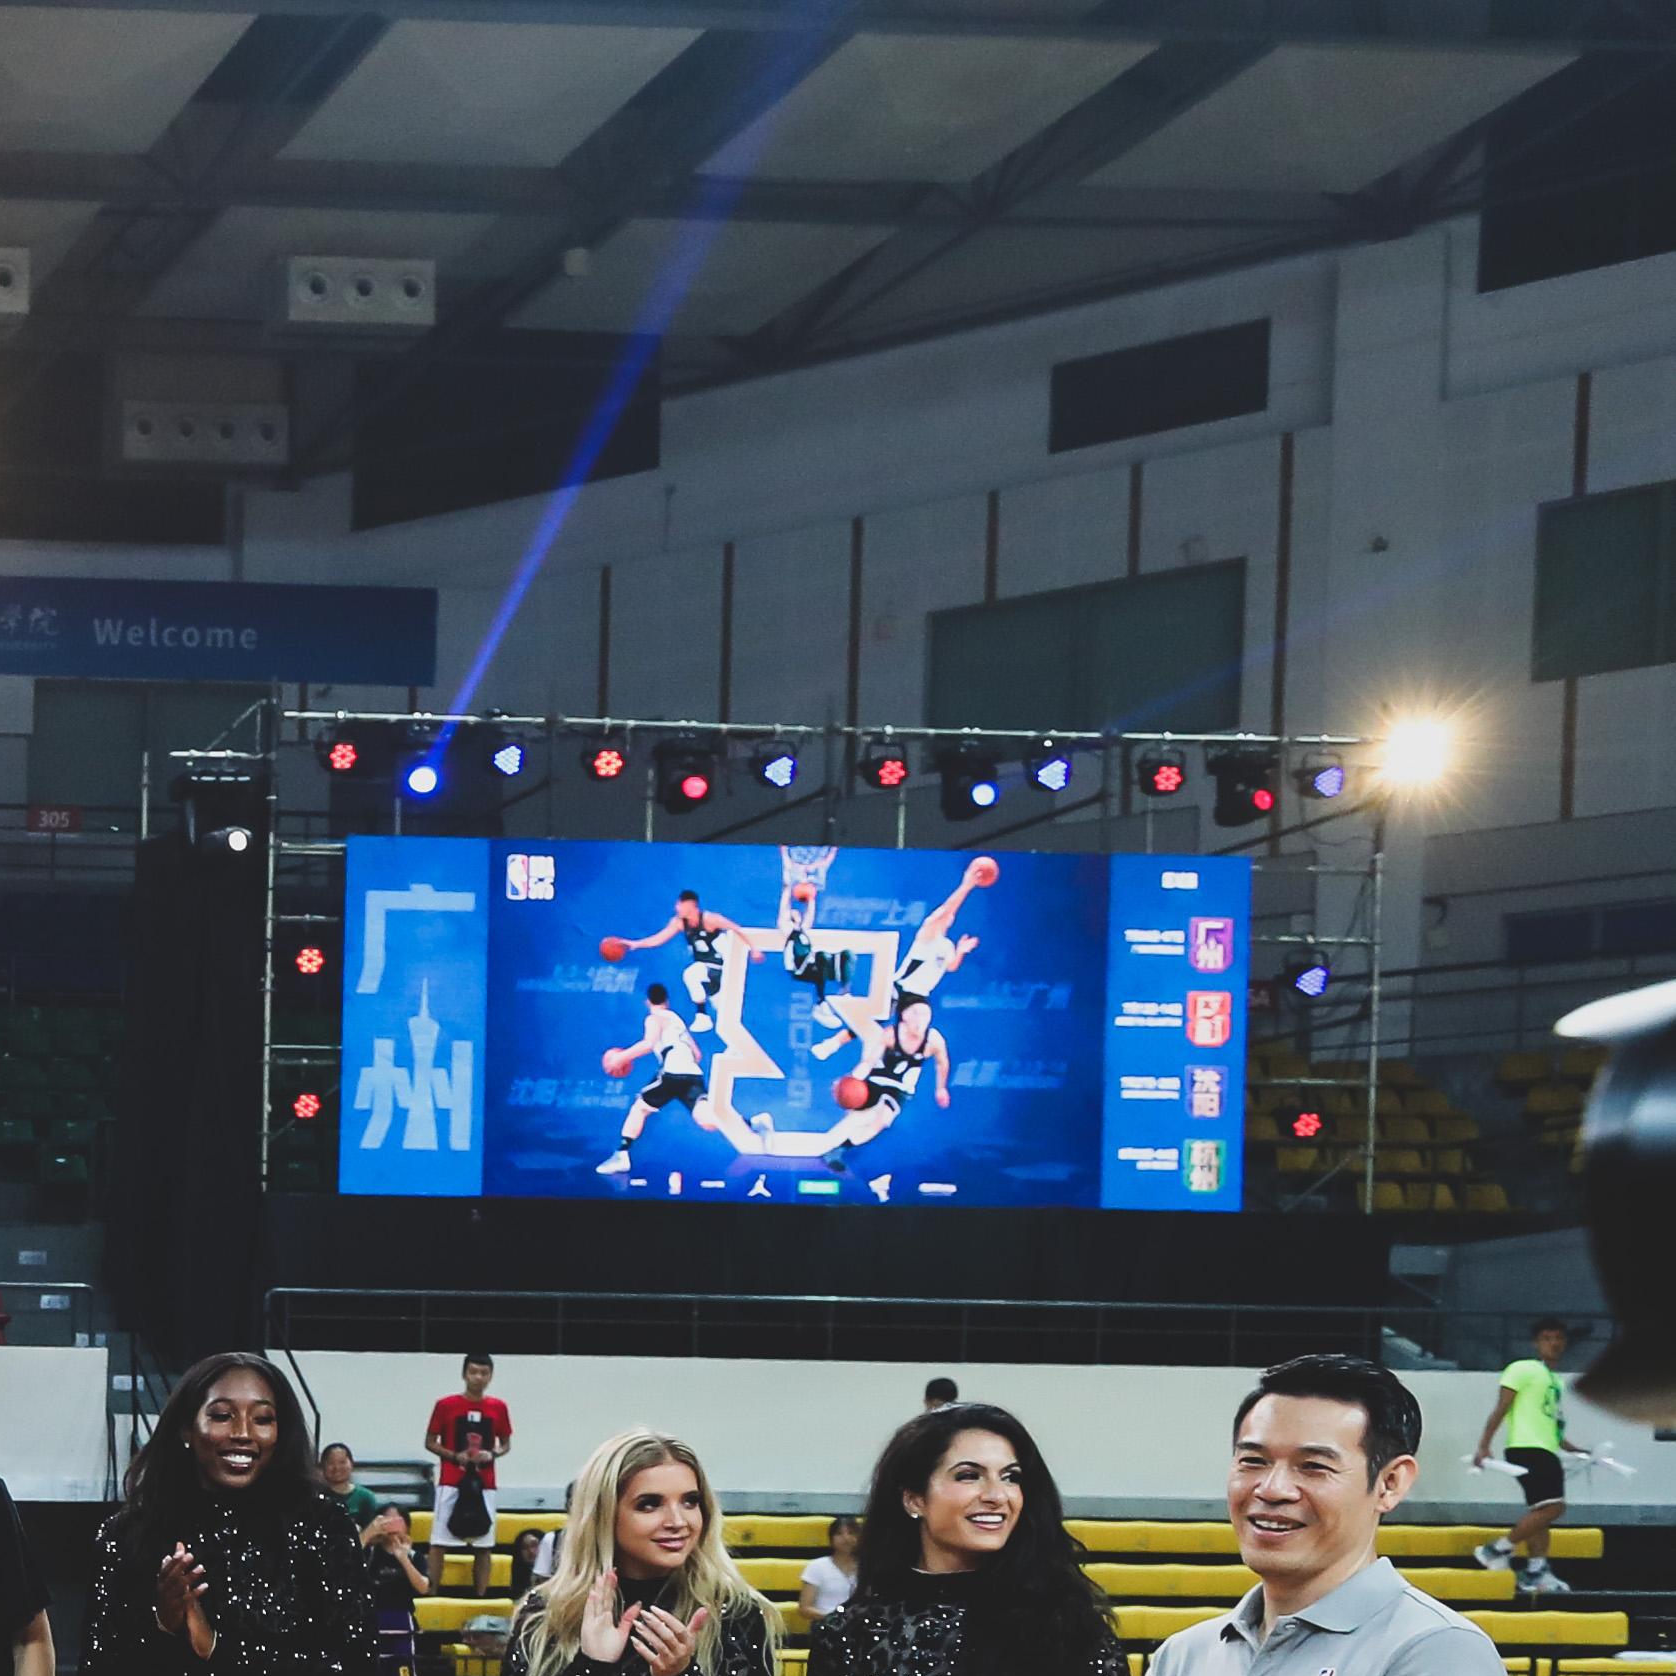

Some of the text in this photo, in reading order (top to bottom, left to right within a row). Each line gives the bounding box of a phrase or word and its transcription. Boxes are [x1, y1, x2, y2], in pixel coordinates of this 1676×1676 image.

[93, 617, 260, 650] Welcome
[38, 810, 71, 828] 305
[354, 883, 476, 1151] 广州
